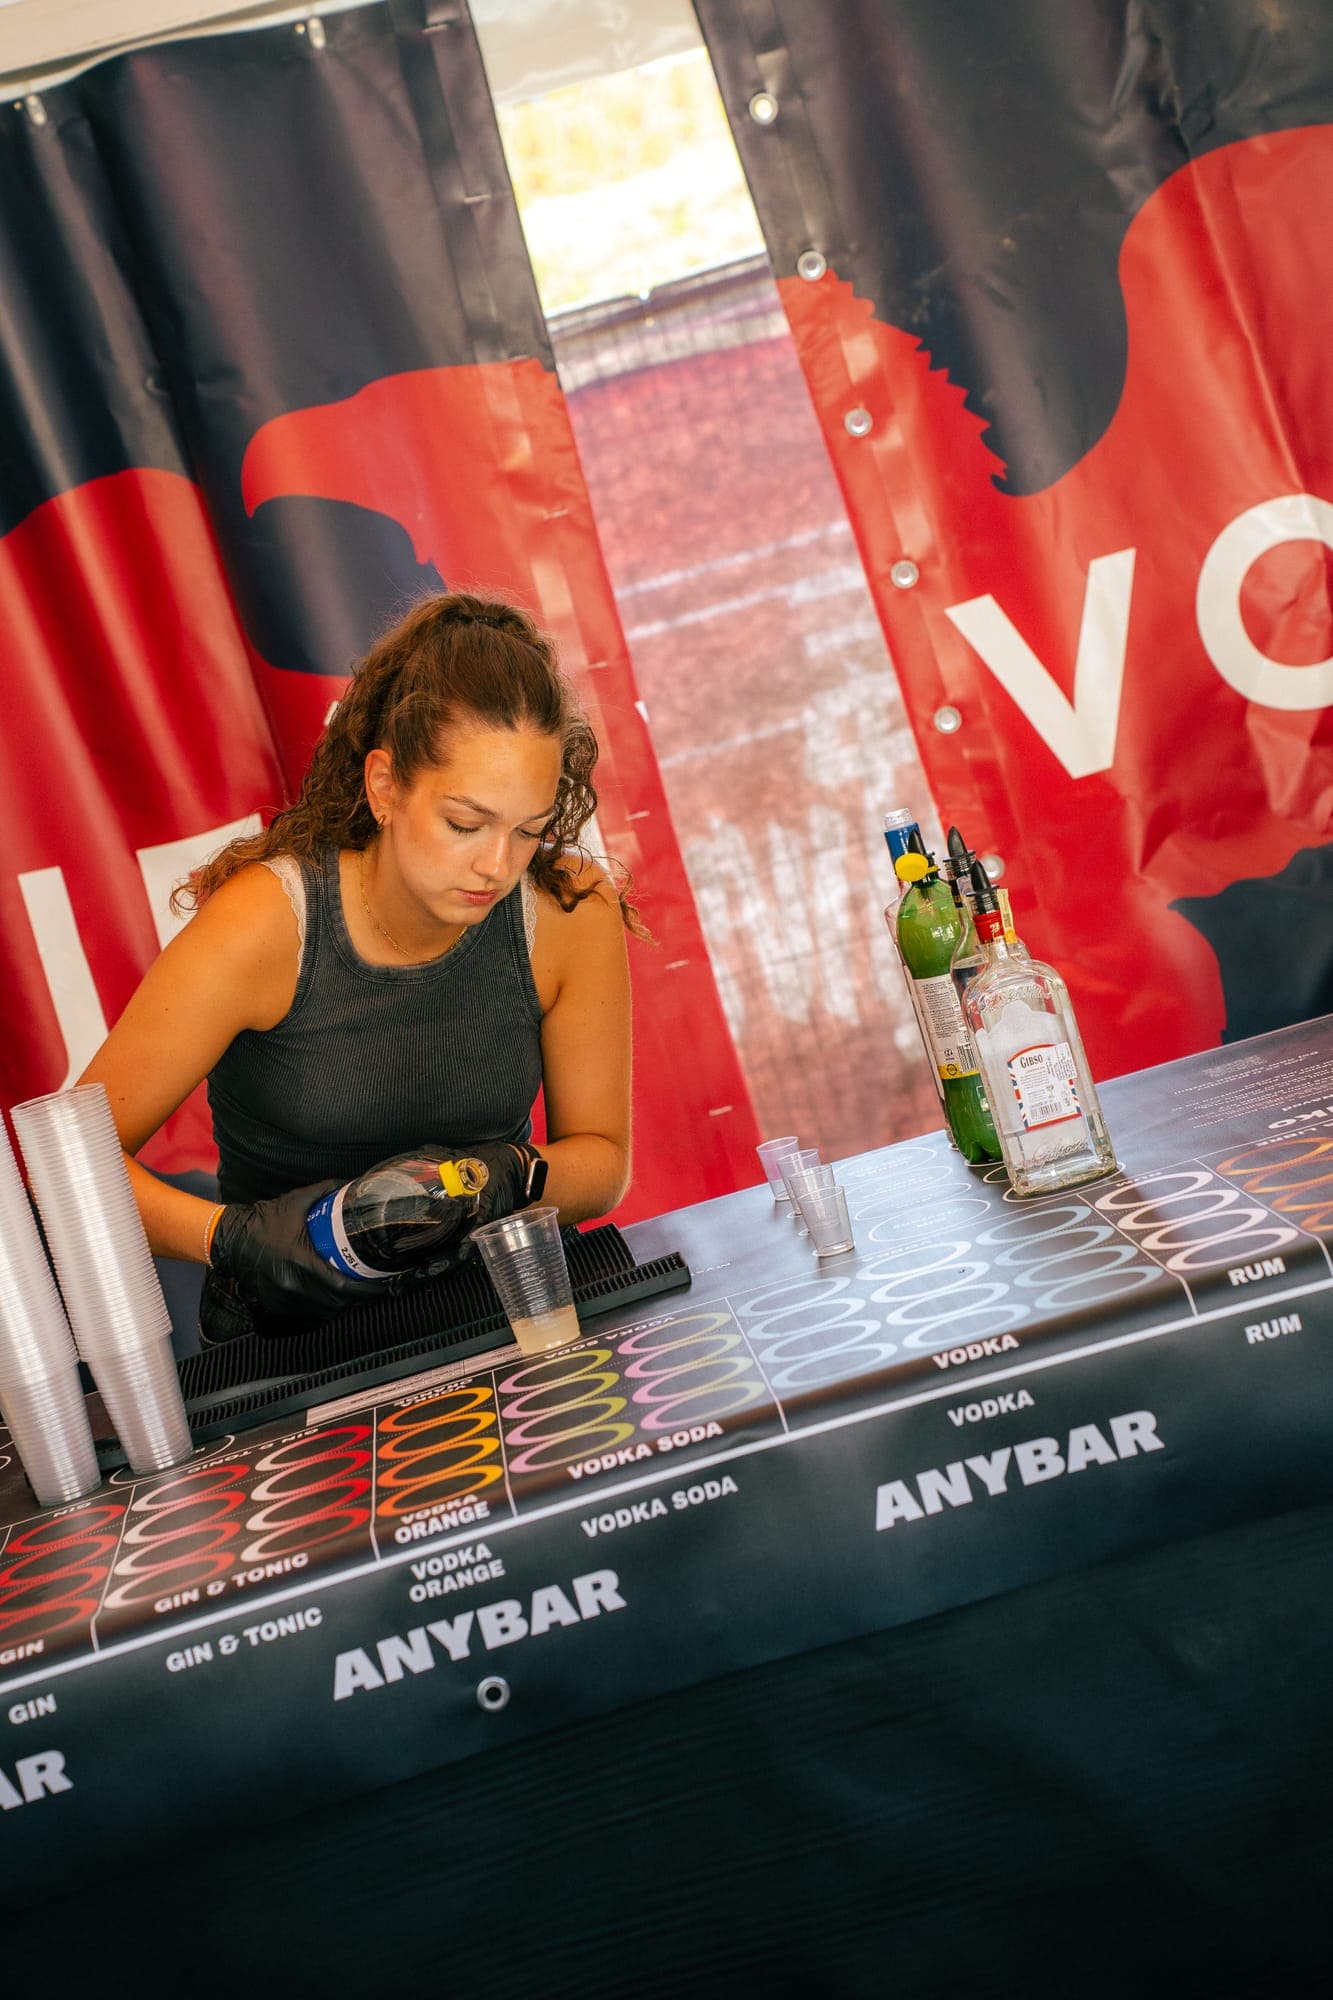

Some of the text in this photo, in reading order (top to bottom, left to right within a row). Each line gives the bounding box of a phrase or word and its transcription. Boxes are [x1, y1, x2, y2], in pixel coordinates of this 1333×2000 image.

[1227, 1256, 1287, 1287] RUM
[604, 1316, 676, 1340] VODKA
[1245, 1313, 1302, 1345] RUM
[544, 1340, 599, 1359] SODA
[932, 1334, 1019, 1370] VODKA
[947, 1389, 1035, 1427] VODKA
[282, 1428, 319, 1443] GIN
[567, 1420, 724, 1480] VODKA SODA
[187, 1450, 252, 1474] TONIC
[875, 1410, 1165, 1531] ANYBAR
[53, 1502, 91, 1518] GIN
[394, 1500, 491, 1544] ORANGE
[400, 1494, 478, 1524] VODKA
[581, 1475, 739, 1538] VODKA SODA
[410, 1542, 492, 1580] VODKA
[154, 1552, 309, 1613] GIN & TONIC
[409, 1558, 506, 1602] ORANGE
[0, 1639, 44, 1665] GIN
[166, 1607, 323, 1672] GIN & TONIC
[333, 1568, 627, 1700] ANYBAR
[8, 1693, 57, 1724] GIN
